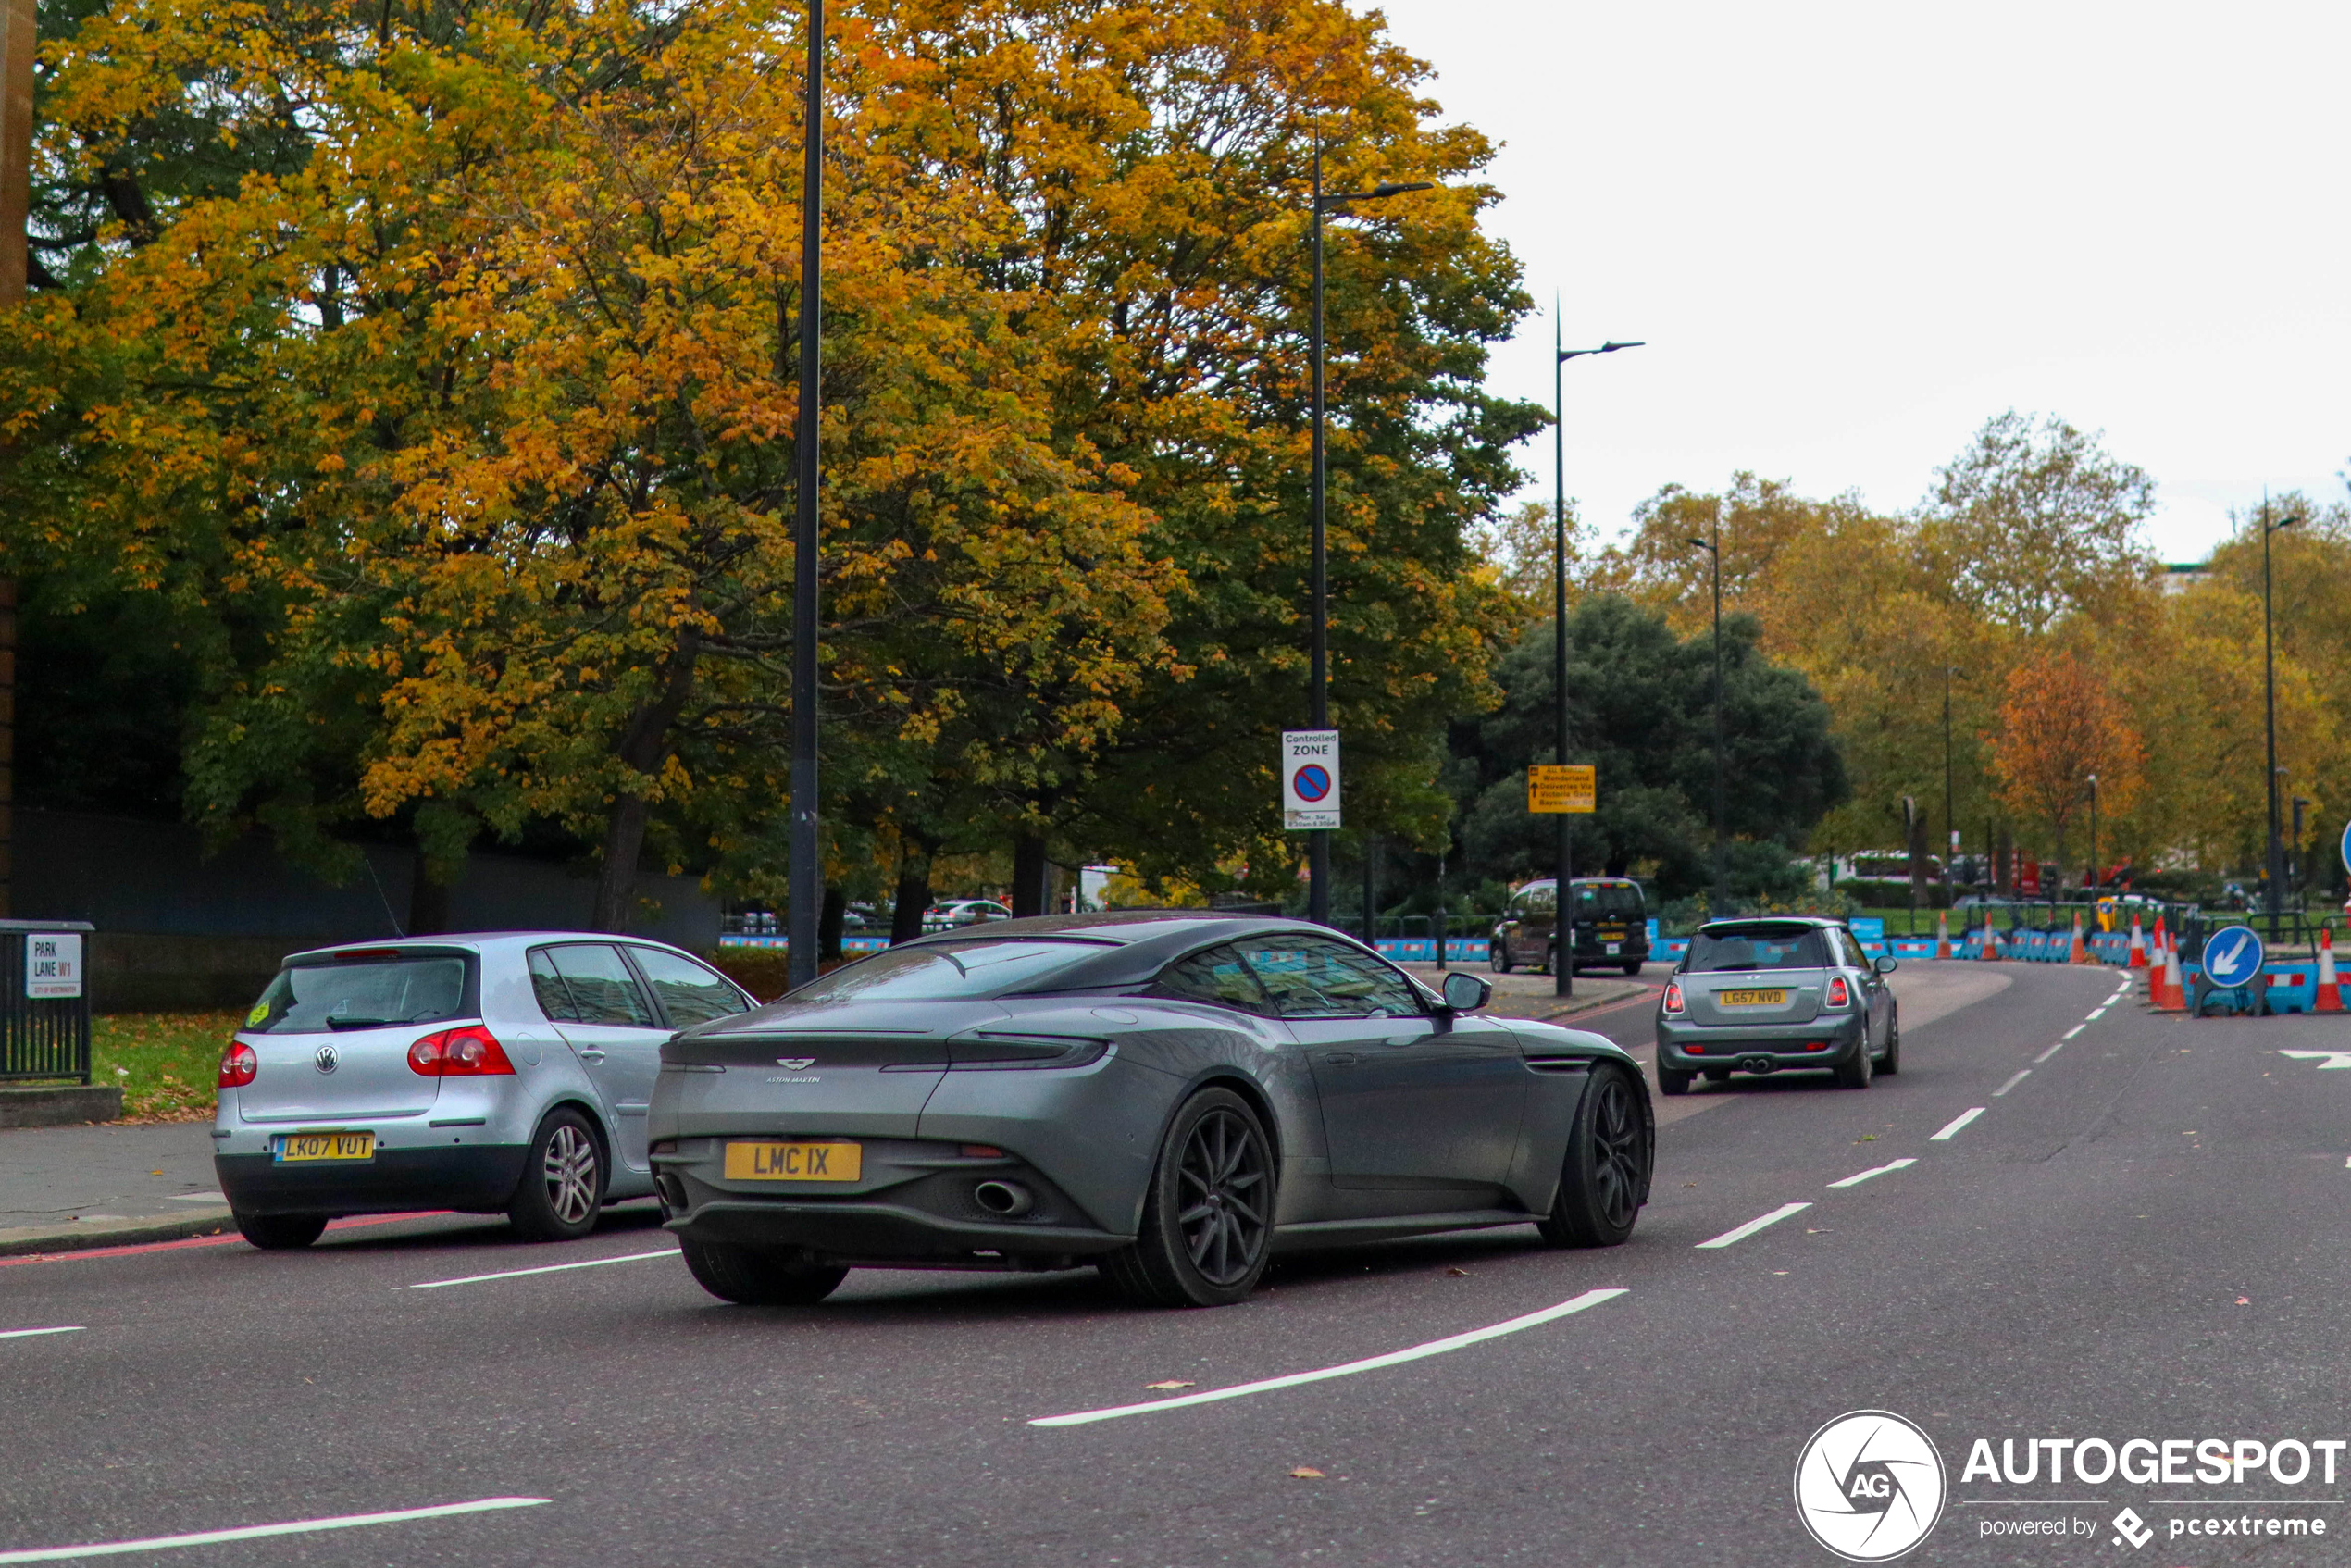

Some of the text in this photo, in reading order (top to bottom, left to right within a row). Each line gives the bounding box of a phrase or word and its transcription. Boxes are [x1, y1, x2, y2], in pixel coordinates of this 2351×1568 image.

[1286, 734, 1337, 742] Controlled
[1293, 745, 1329, 755] ZONE
[35, 942, 56, 957] PARK
[35, 962, 71, 977] LANE W1
[1724, 991, 1781, 1003] LG57 NVD
[286, 1137, 369, 1157] LK07 VUT
[754, 1147, 801, 1174] LMC
